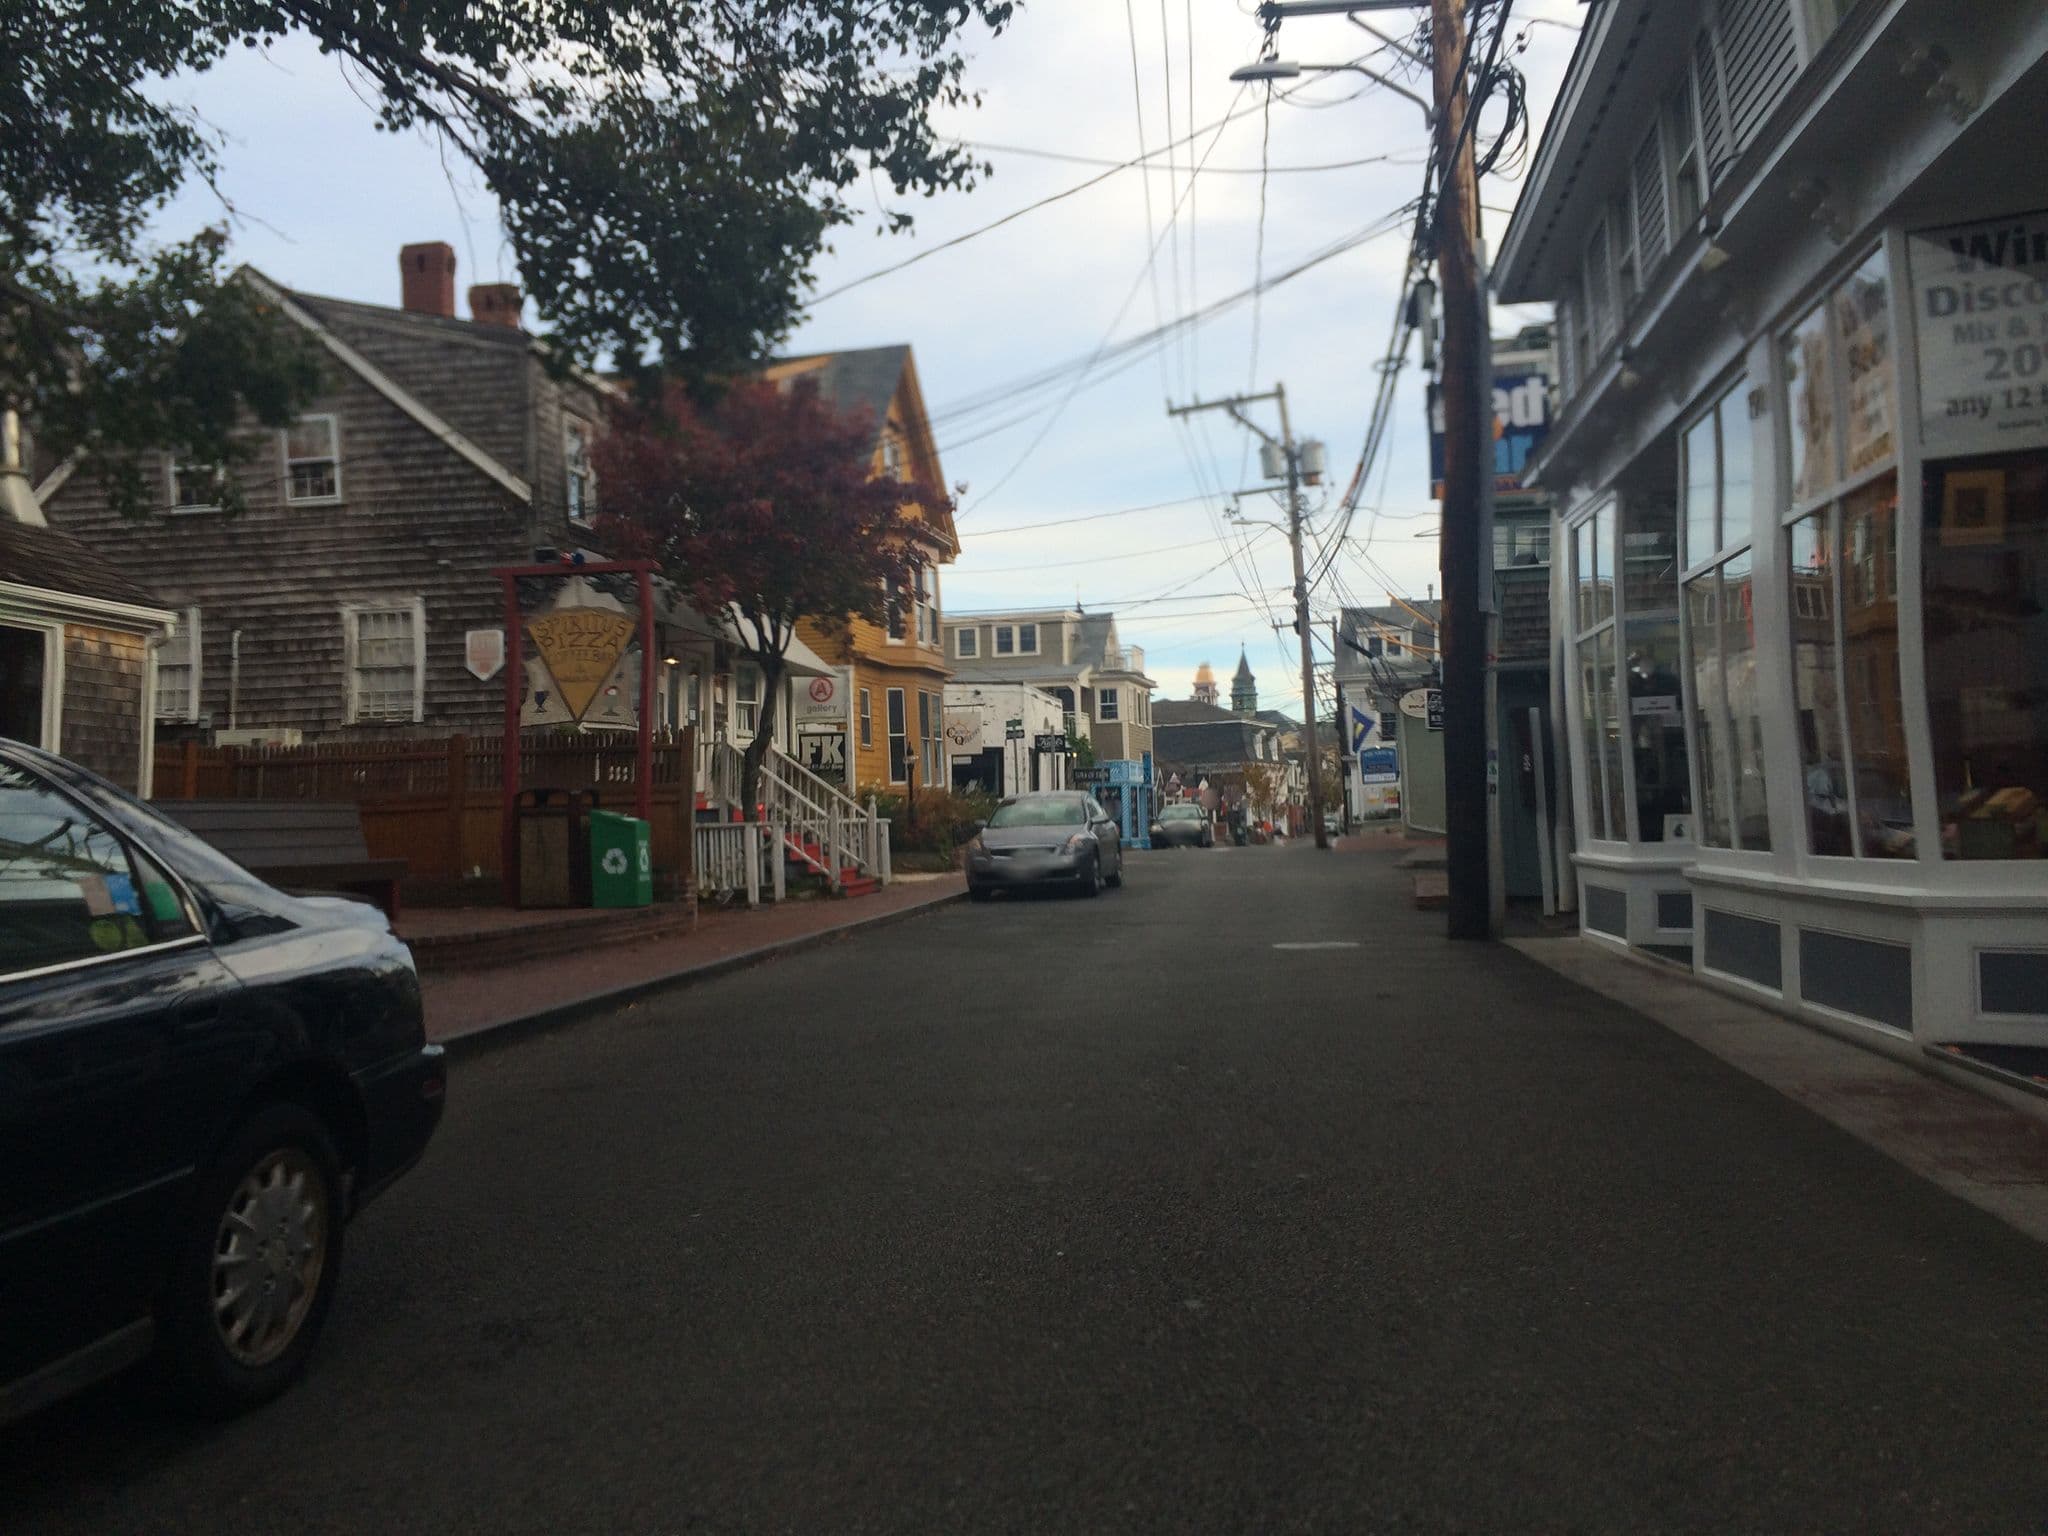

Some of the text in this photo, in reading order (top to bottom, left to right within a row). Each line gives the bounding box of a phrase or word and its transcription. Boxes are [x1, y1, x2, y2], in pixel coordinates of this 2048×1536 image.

[1984, 344, 2048, 381] 20
[1946, 397, 1991, 419] any
[2003, 386, 2032, 409] 12
[806, 703, 837, 714] gallery
